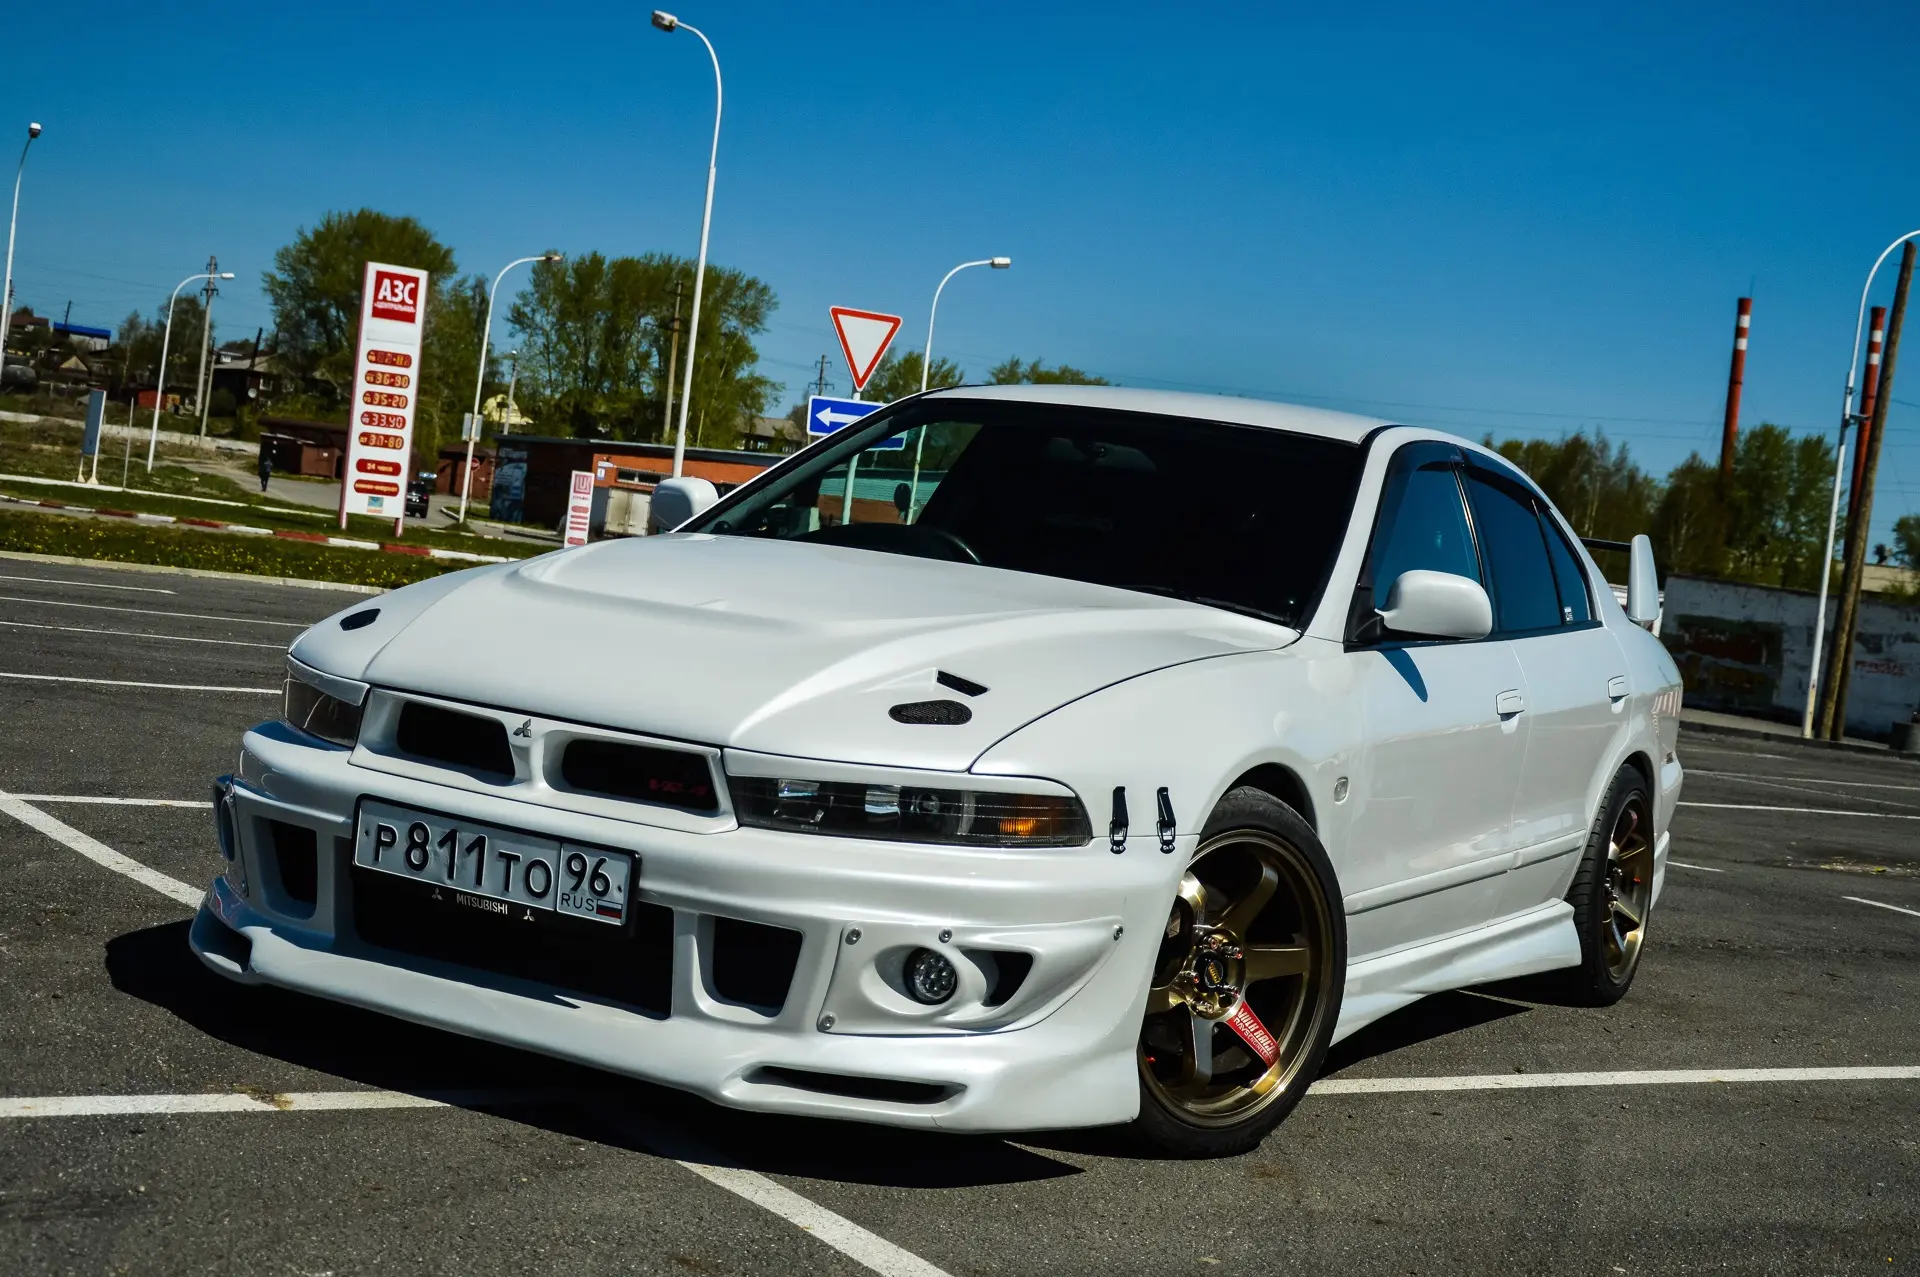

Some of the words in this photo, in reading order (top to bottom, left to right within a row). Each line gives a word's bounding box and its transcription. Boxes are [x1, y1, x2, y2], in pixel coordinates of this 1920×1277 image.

[378, 278, 416, 305] АЗС
[565, 852, 611, 897] 96
[456, 893, 508, 915] MITSUBISHI
[561, 893, 595, 912] RUS
[1233, 1017, 1251, 1037] RAYS
